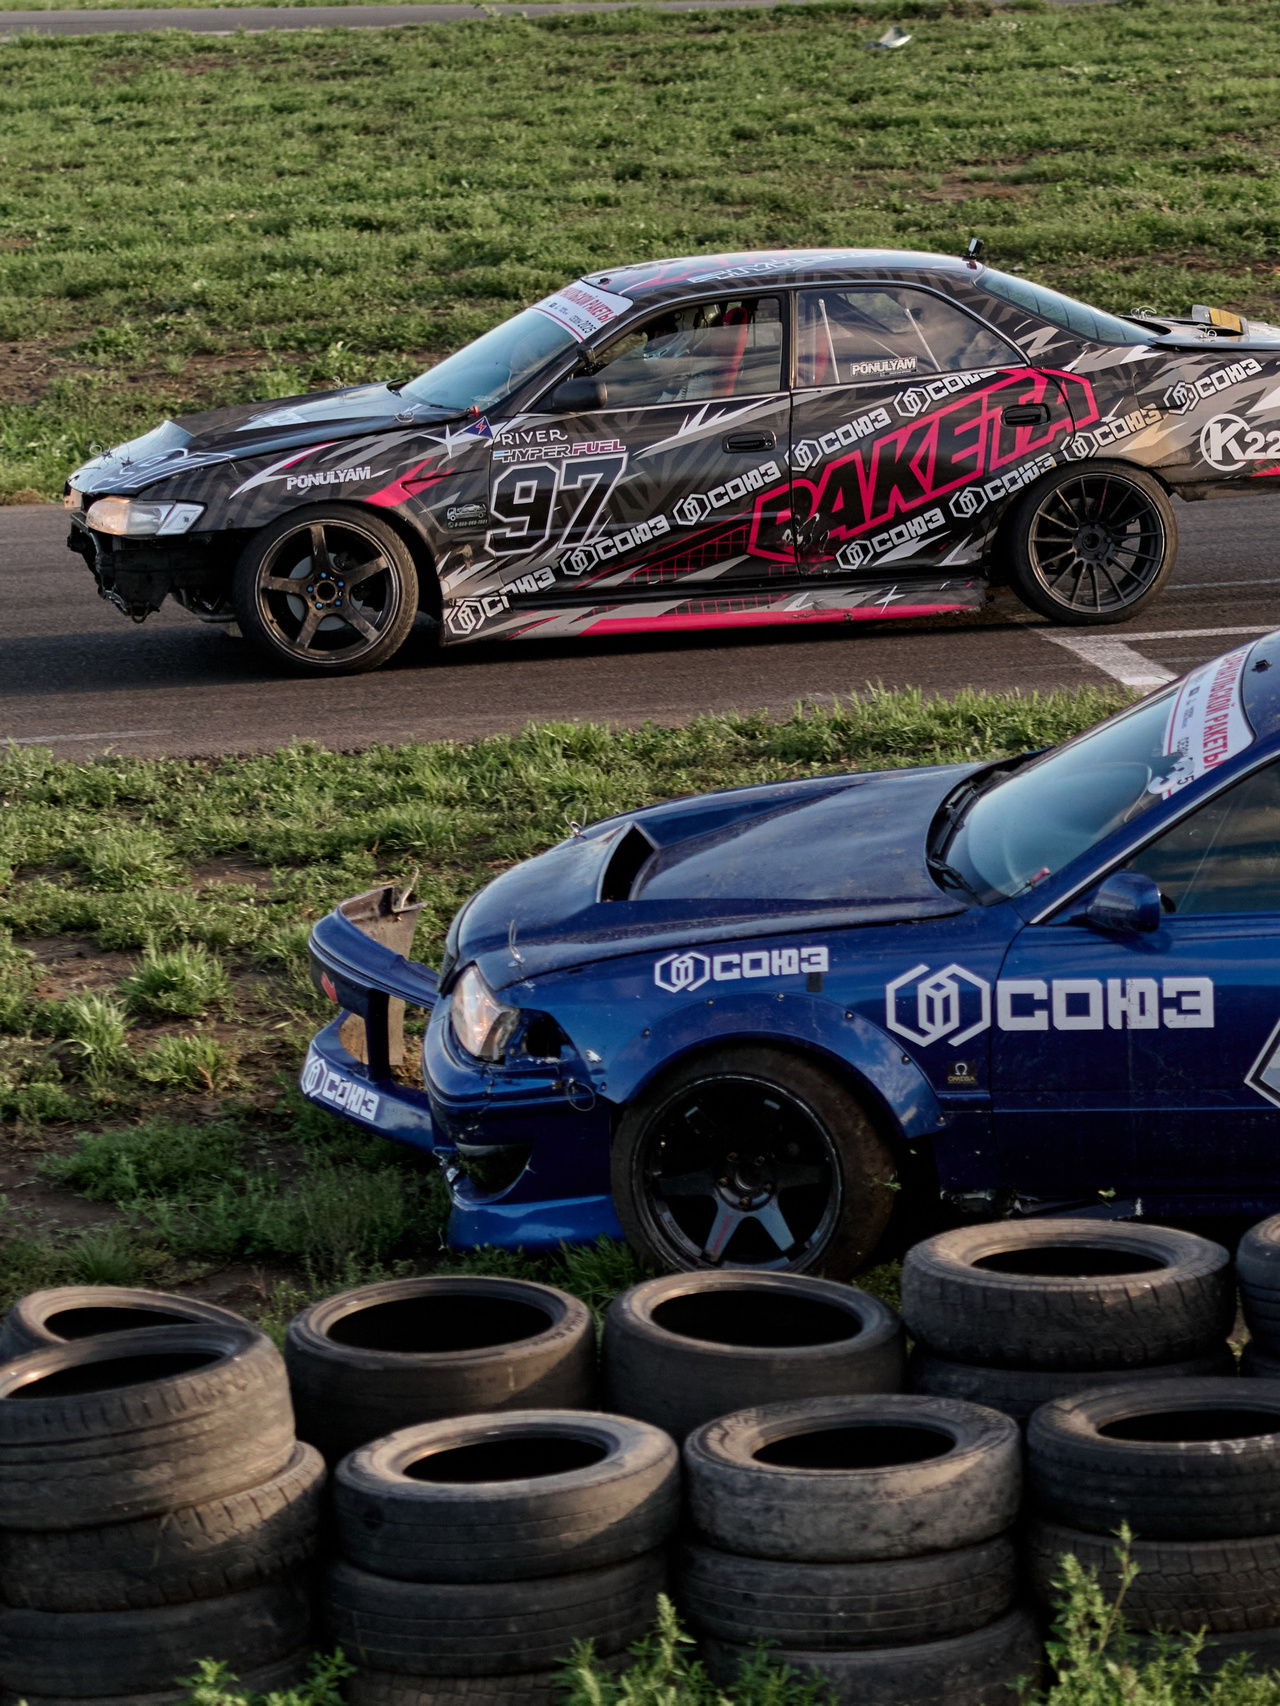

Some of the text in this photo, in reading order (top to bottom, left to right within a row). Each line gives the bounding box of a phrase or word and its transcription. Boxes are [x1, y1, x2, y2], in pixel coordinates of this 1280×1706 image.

[577, 319, 597, 334] 2025
[852, 358, 916, 376] PONULYAM
[1194, 358, 1263, 399] СОЮЗ
[499, 429, 568, 446] RIVER
[818, 407, 892, 454] СОЮЗ
[1093, 403, 1163, 447] СОЮЗ
[286, 466, 371, 491] PONULYAM
[708, 460, 781, 509] СОЮЗ
[983, 452, 1057, 502] СОЮЗ
[484, 452, 629, 556] 97
[596, 516, 671, 561] СОЮЗ
[874, 507, 946, 553] СОЮЗ
[713, 946, 829, 981] СОЮЗ
[996, 976, 1215, 1031] СОЮЗ
[322, 1071, 380, 1121] СОЮЗ
